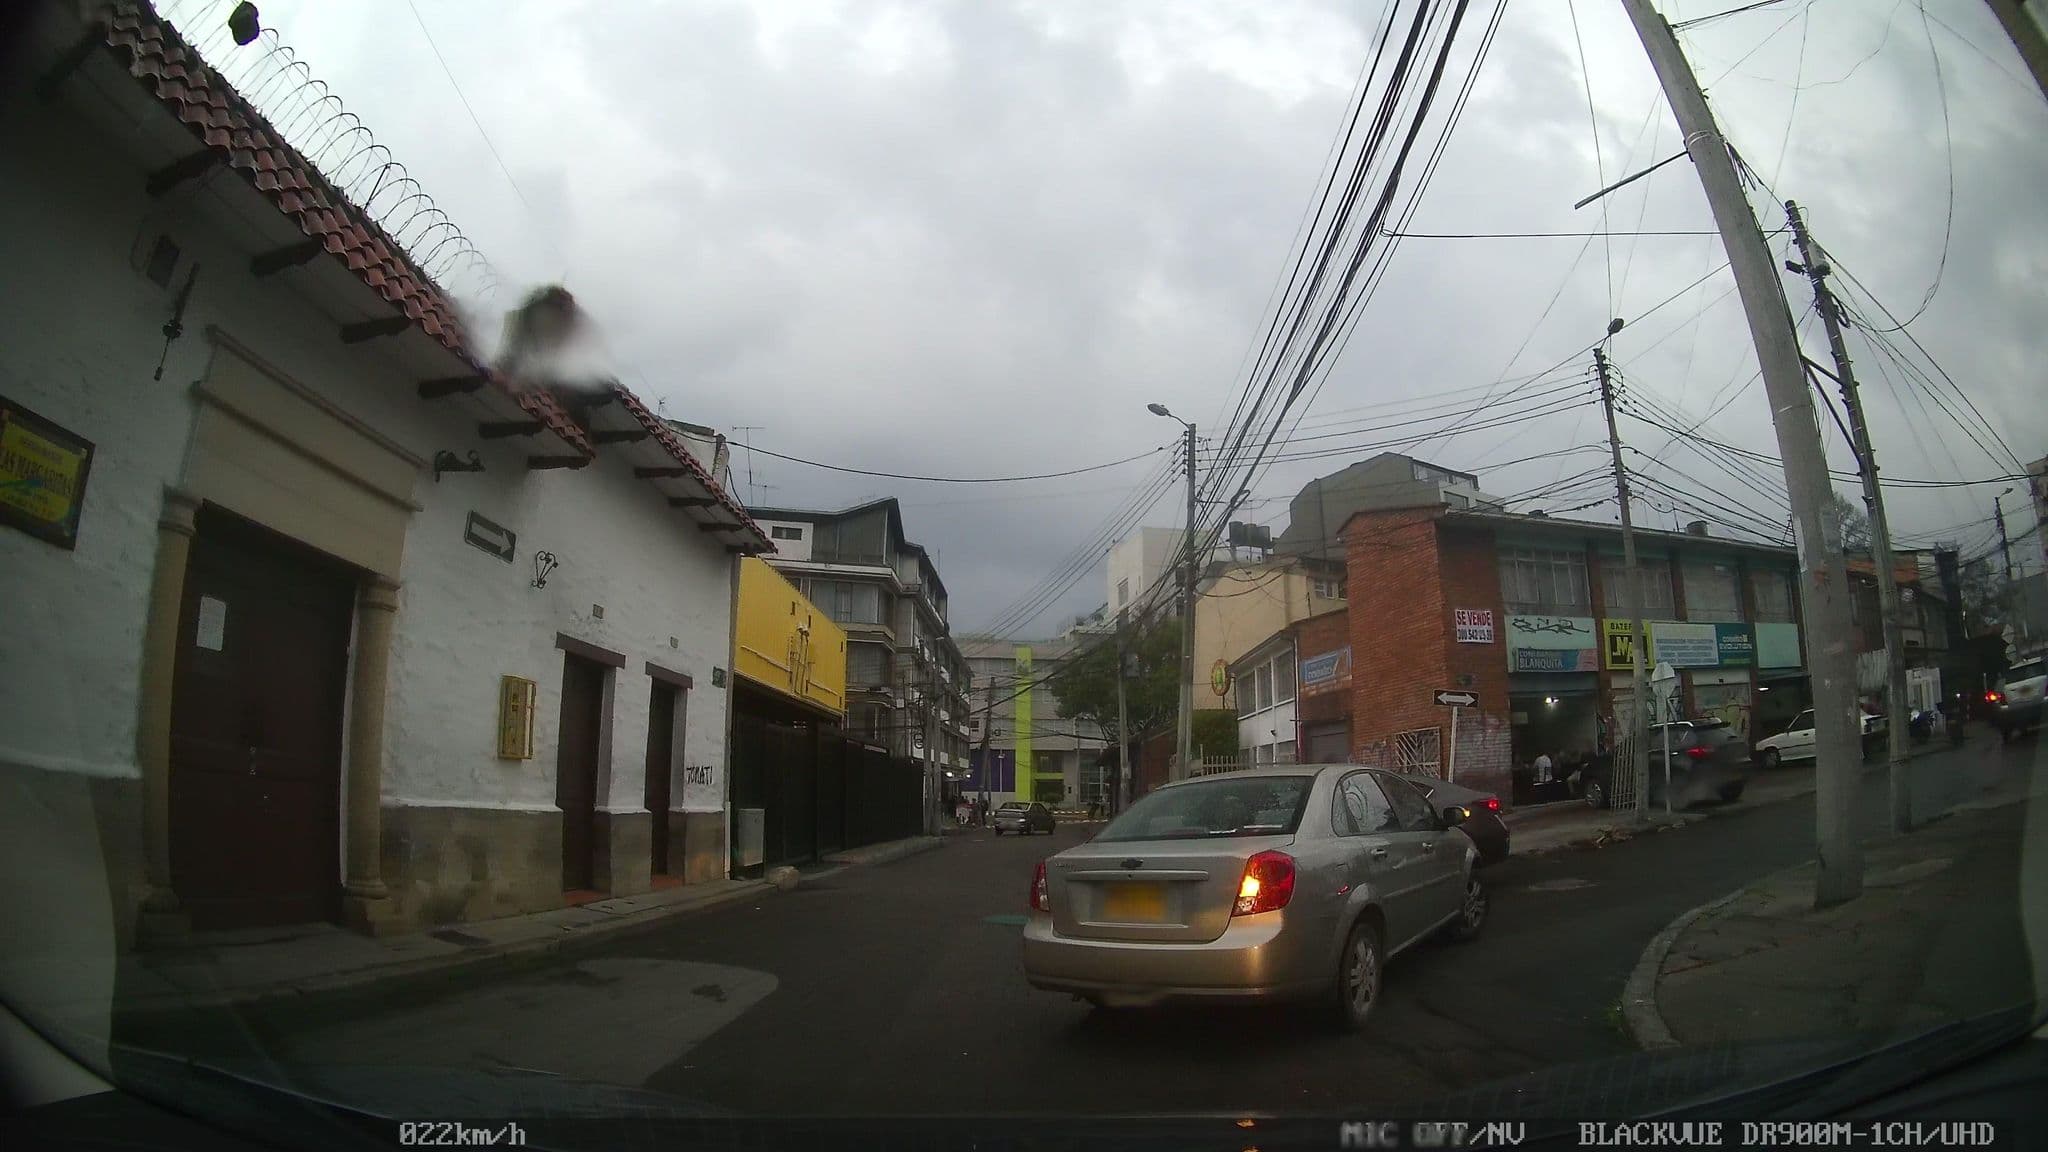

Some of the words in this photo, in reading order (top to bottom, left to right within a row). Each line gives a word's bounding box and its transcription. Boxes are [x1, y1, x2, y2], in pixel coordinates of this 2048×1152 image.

[1456, 610, 1467, 626] SE
[1467, 611, 1492, 626] VENDE
[1519, 656, 1563, 669] BLANQUITA
